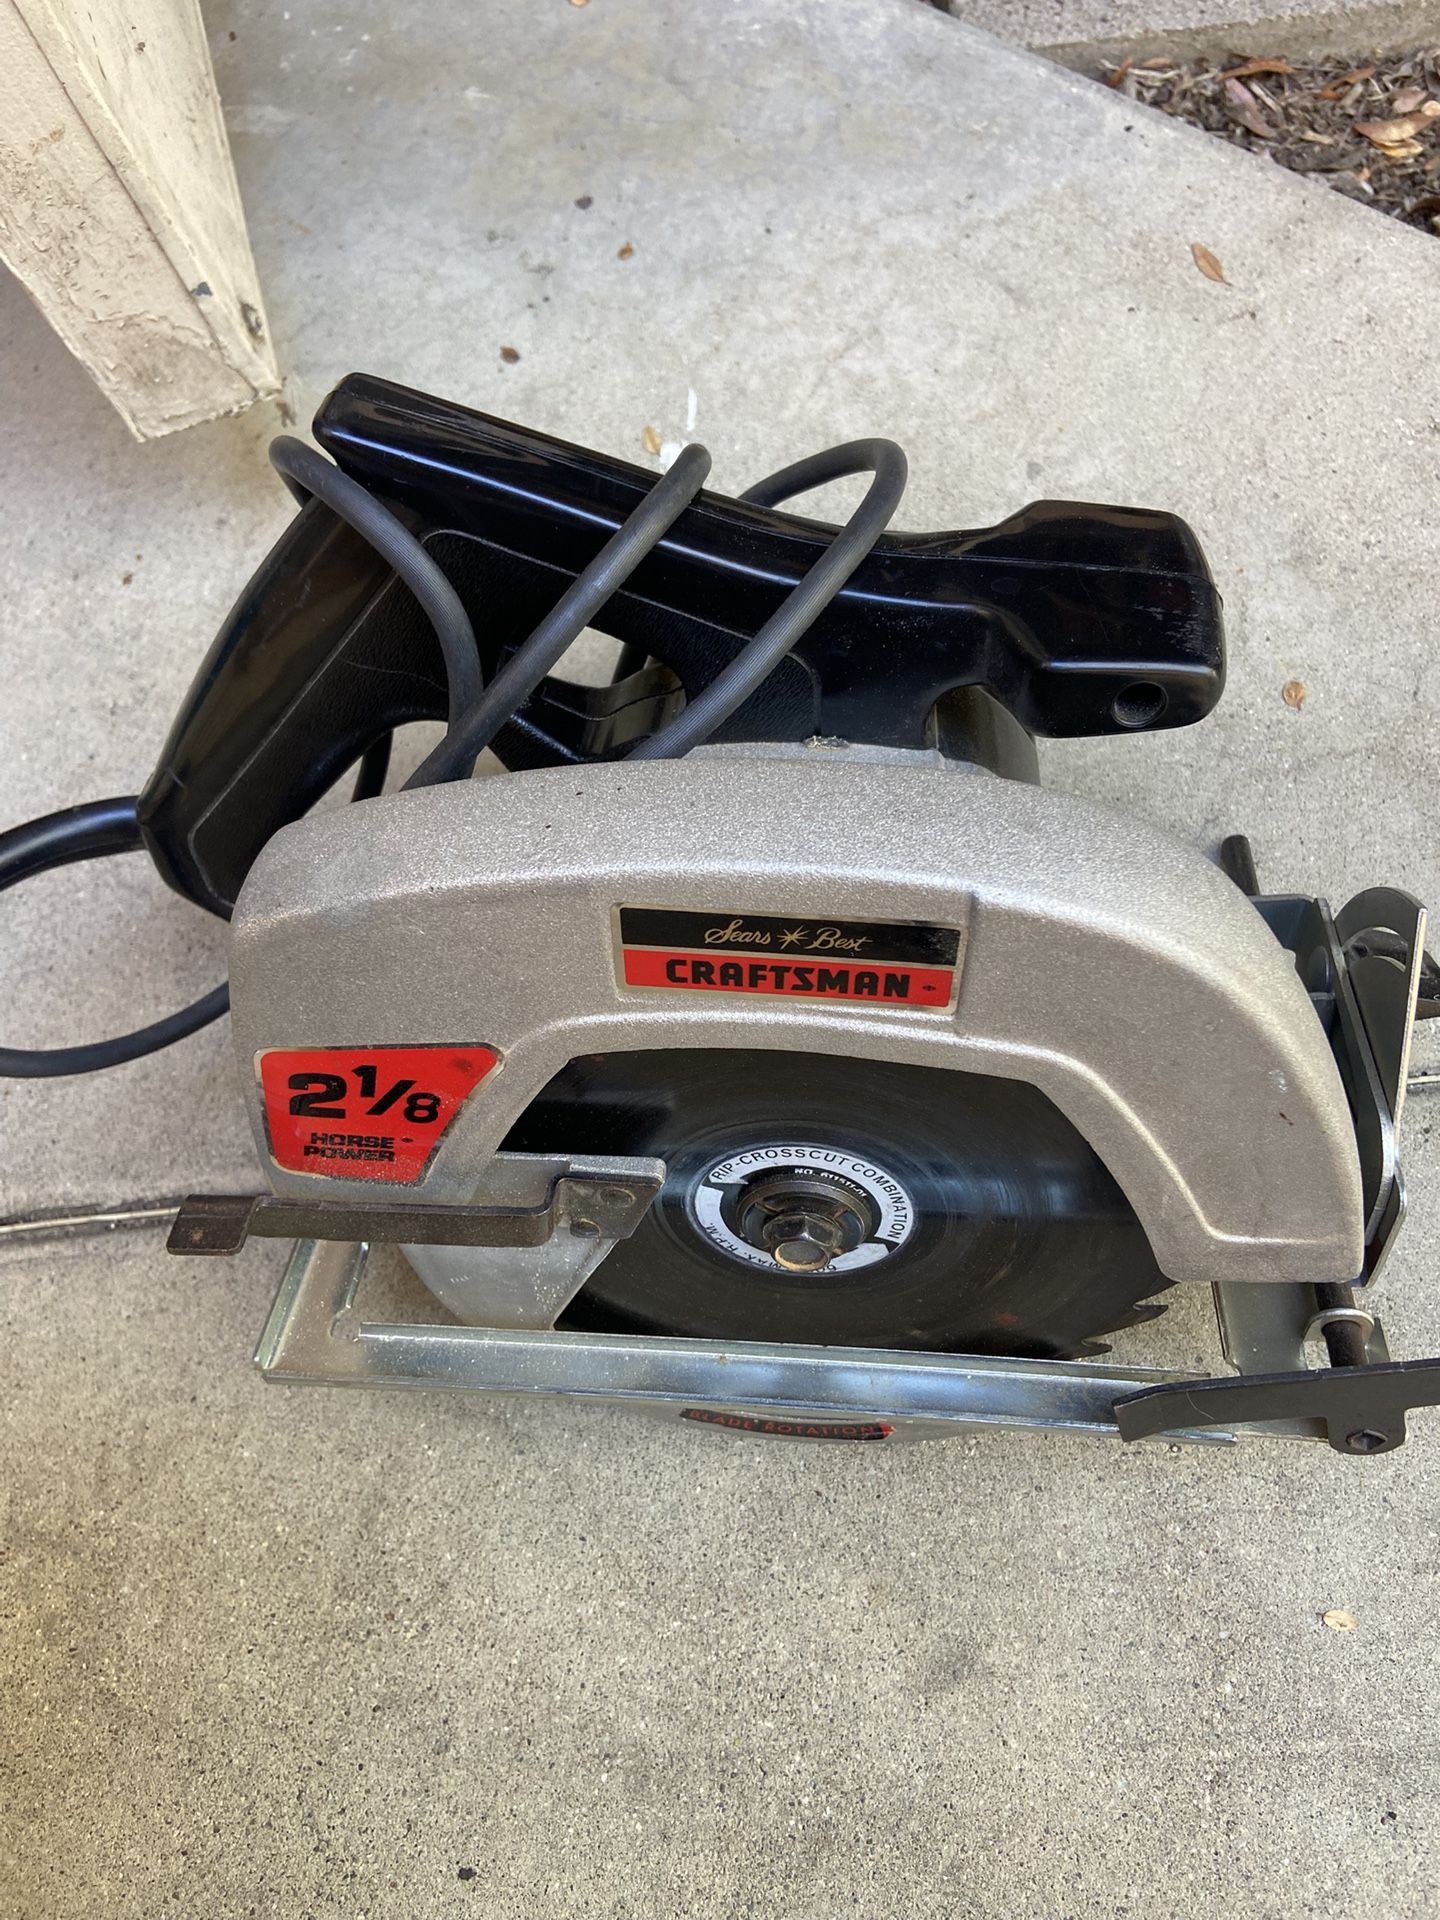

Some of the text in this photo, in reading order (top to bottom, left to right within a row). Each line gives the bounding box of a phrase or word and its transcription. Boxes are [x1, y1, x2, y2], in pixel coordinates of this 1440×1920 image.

[704, 918, 873, 951] Sears Best
[665, 958, 911, 998] CRAFTSMAN
[303, 1145, 396, 1162] POWER
[310, 1132, 396, 1150] HORSE
[711, 1148, 908, 1240] RIP-CROSSCUT COMBINATION
[688, 1408, 876, 1436] BLADE ROTATION
